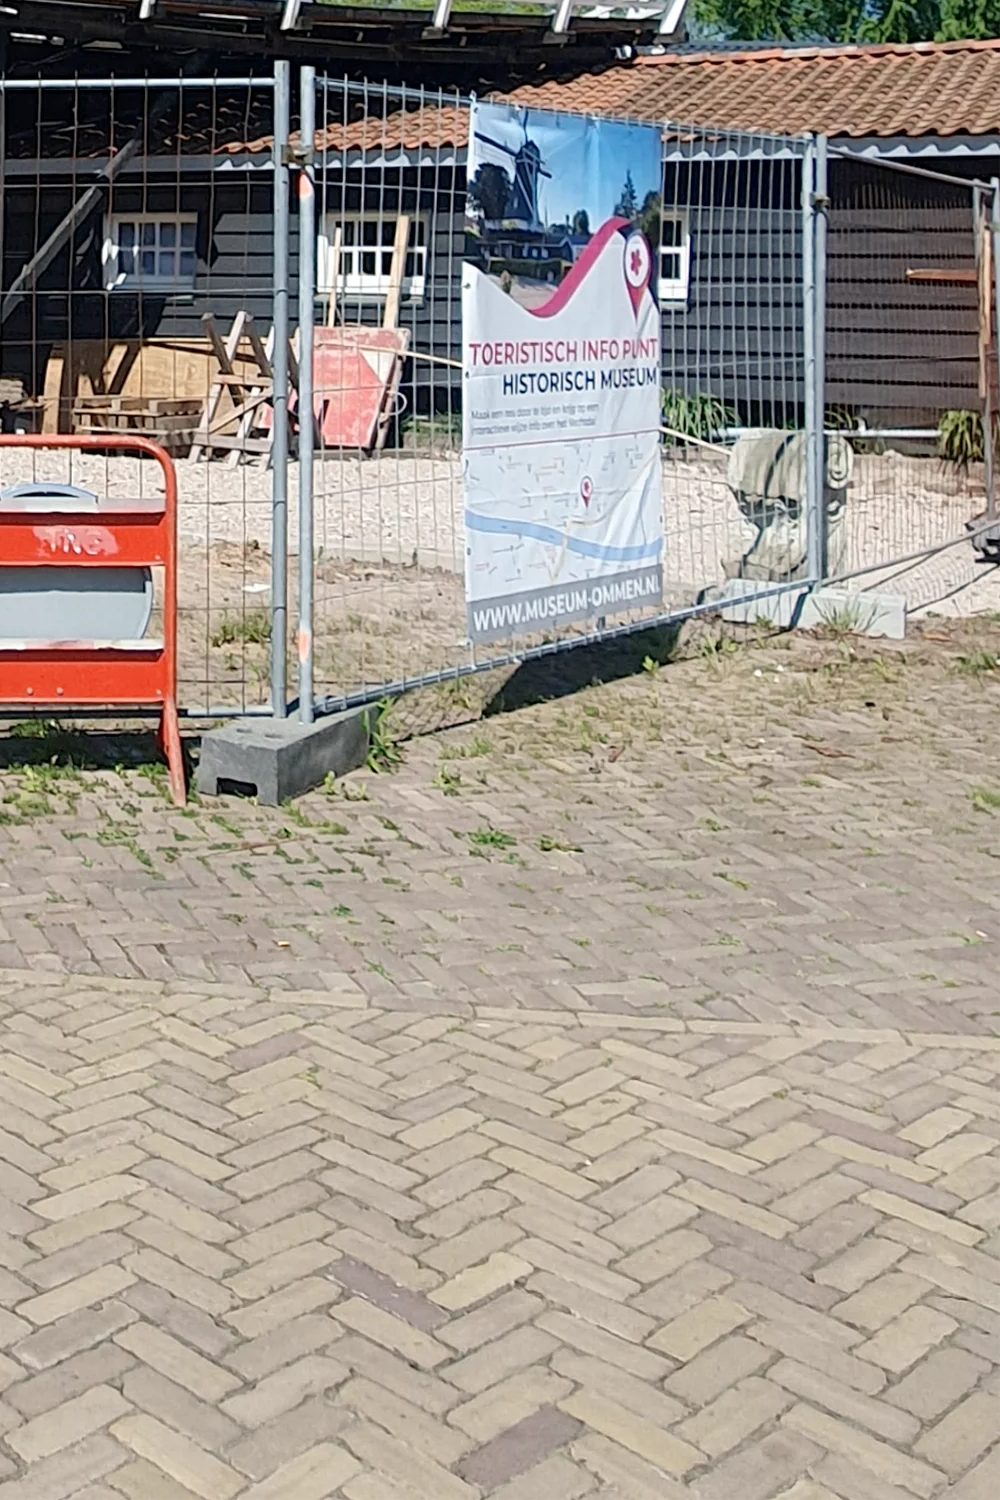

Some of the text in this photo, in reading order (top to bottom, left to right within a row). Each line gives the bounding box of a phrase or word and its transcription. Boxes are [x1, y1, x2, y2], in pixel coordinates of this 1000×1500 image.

[469, 337, 658, 366] TOERISTISCH INFO PUNT
[503, 367, 657, 396] HISTORISCH MUSEUM
